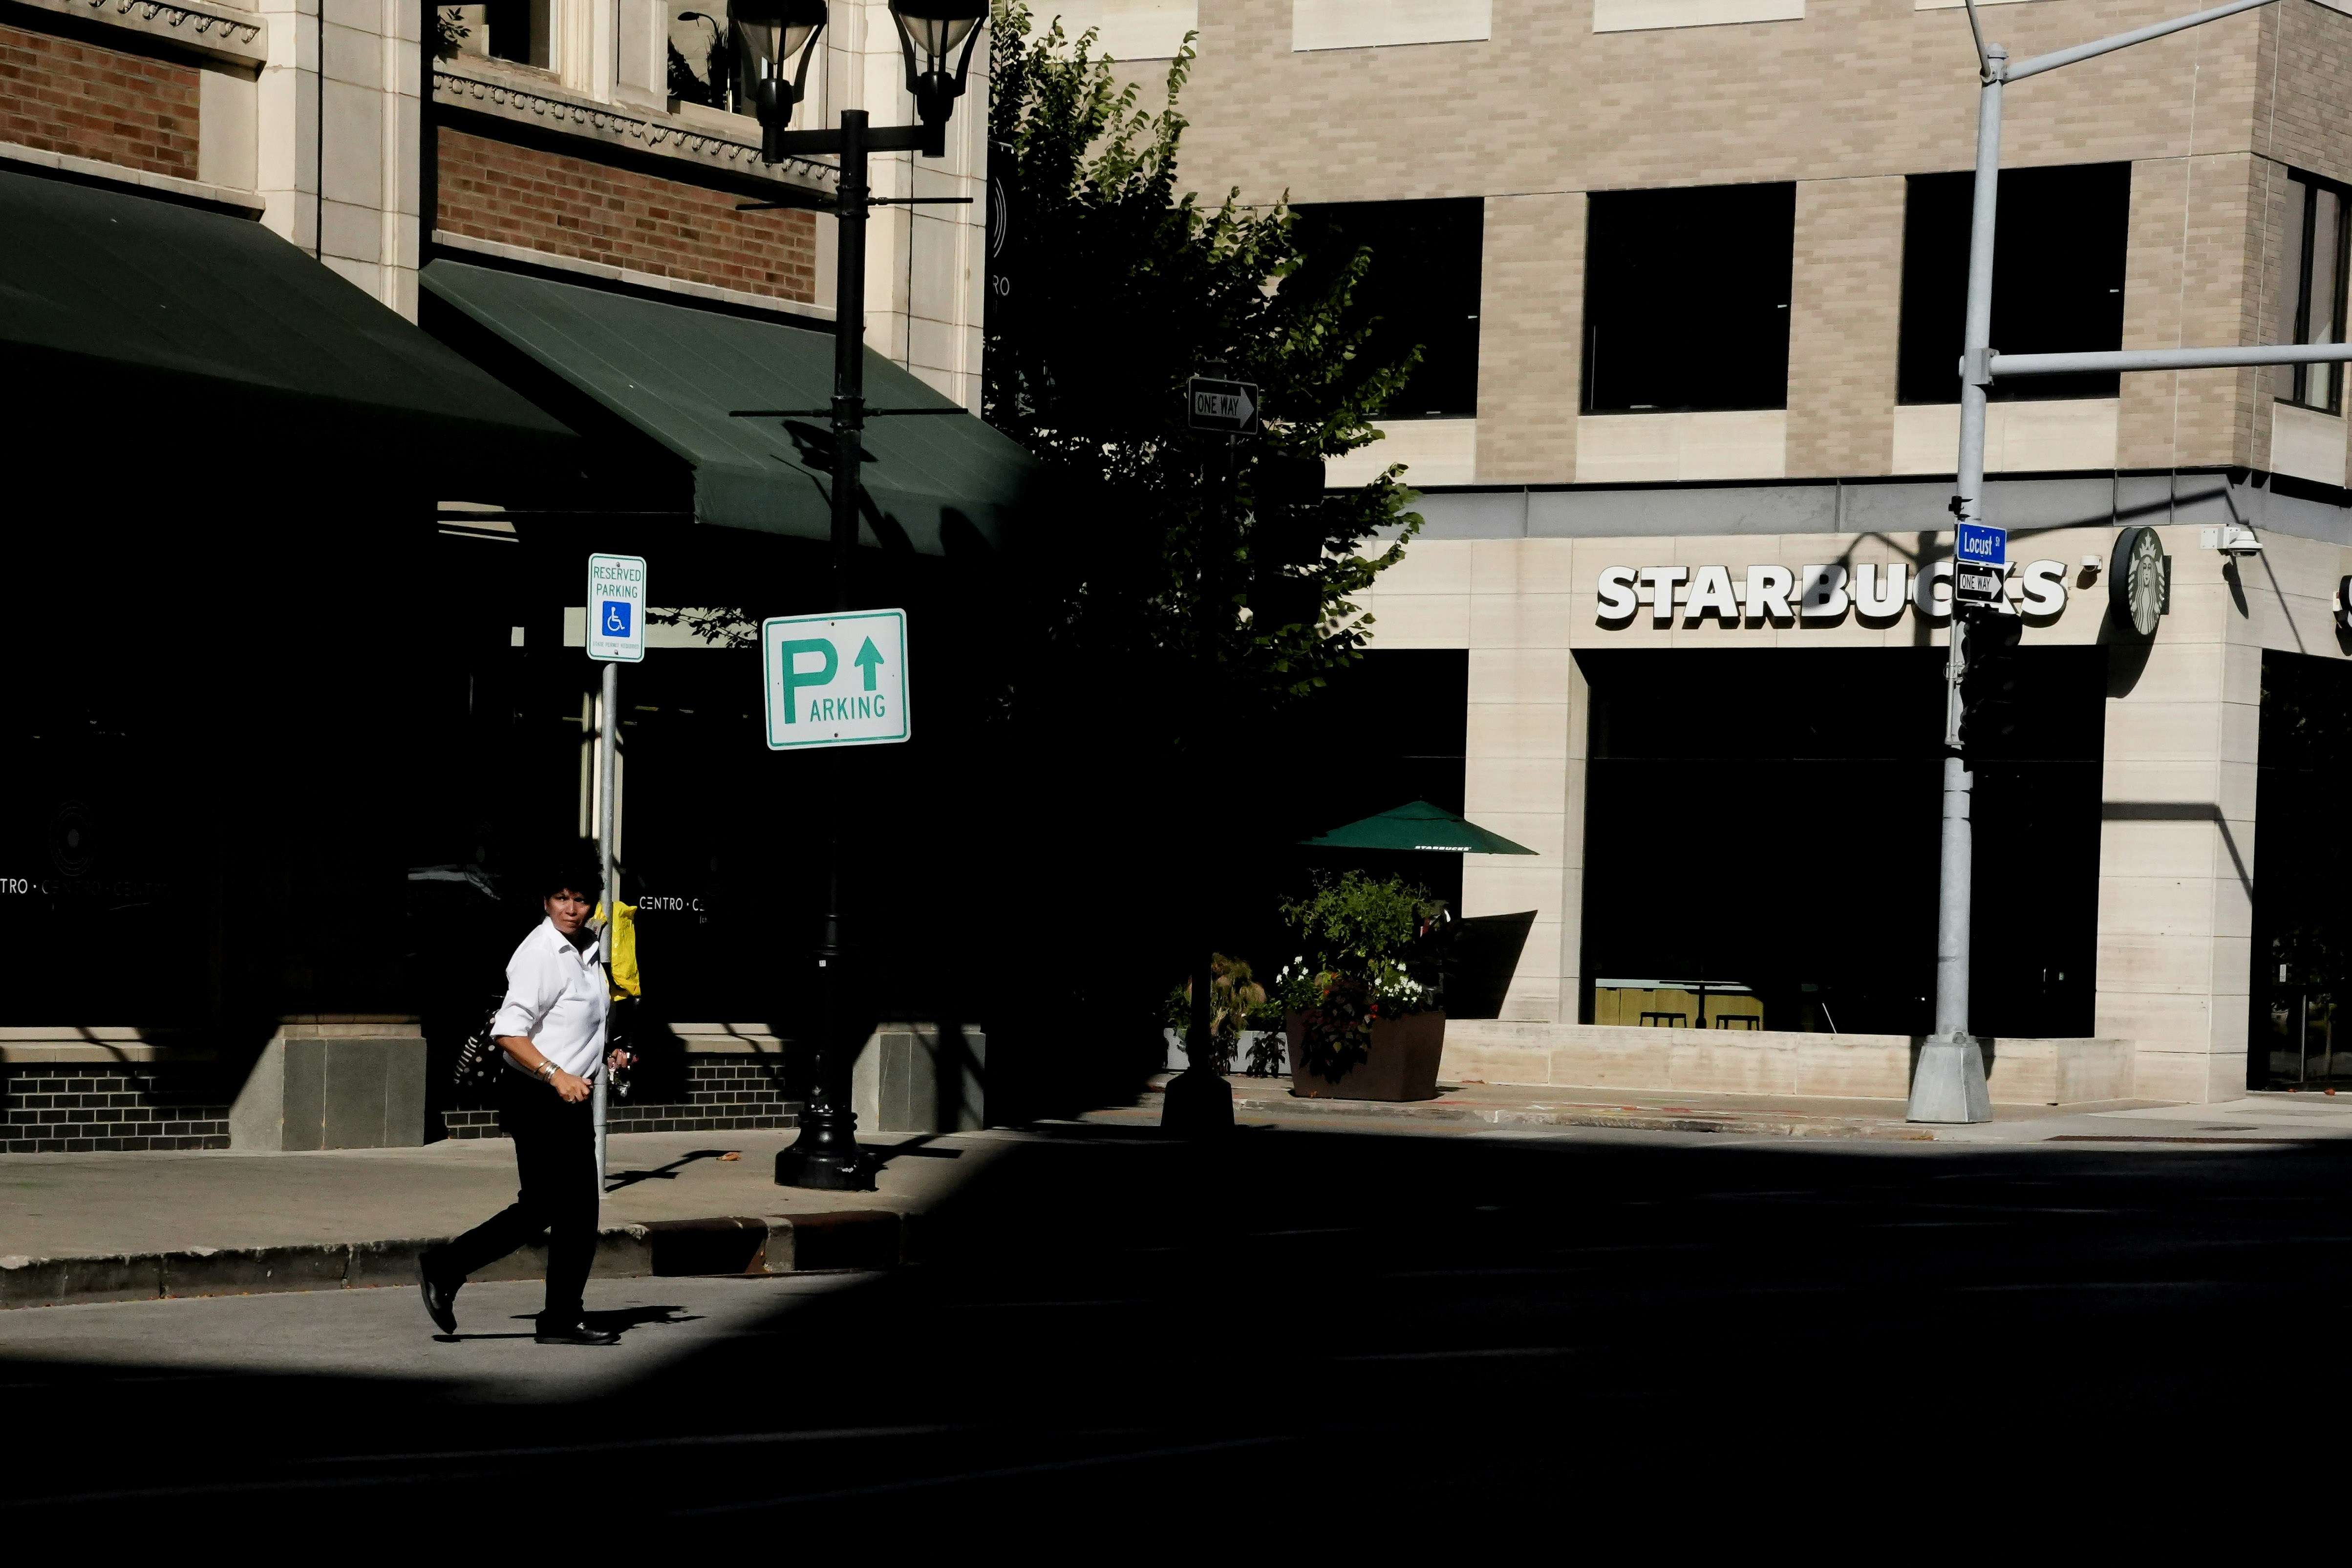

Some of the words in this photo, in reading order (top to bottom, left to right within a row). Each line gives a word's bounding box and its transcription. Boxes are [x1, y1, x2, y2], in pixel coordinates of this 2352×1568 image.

[1197, 394, 1217, 414] ONE
[1220, 396, 1239, 416] WAY
[1965, 532, 1992, 555] Locust
[594, 566, 641, 581] RESERVED
[597, 583, 638, 598] PARKING
[1962, 575, 1975, 589] ONE
[1978, 577, 1990, 591] WAY
[640, 896, 683, 910] CENTRO
